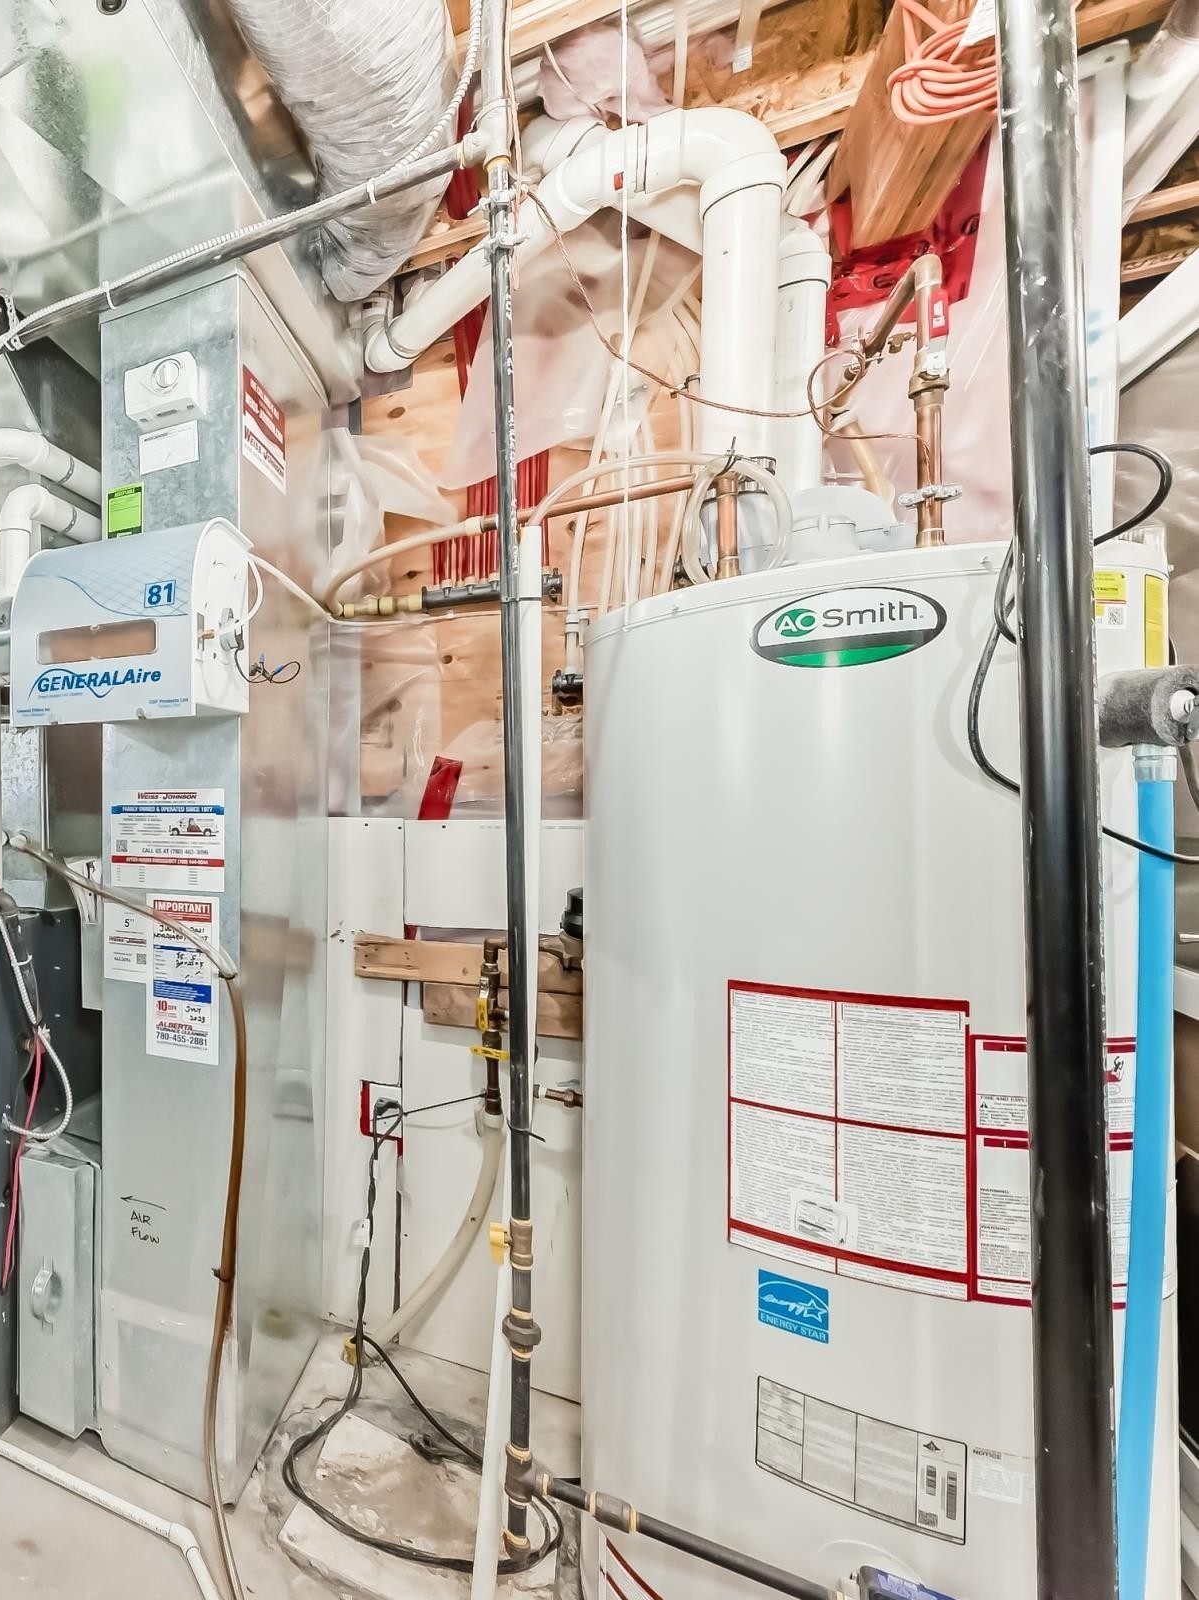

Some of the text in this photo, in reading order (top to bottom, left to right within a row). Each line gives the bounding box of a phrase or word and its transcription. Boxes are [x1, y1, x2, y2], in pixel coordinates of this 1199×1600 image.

[147, 582, 174, 607] 81
[822, 601, 918, 628] Smith
[163, 792, 197, 800] JOHNSON
[155, 901, 210, 914] IMPORTANT!
[158, 1020, 193, 1031] ALBERTA
[156, 1031, 208, 1046] 780-455-2881
[130, 1210, 151, 1226] AIR
[760, 1312, 827, 1341] ENERGY STAR
[972, 1449, 1002, 1460] NOTICE
